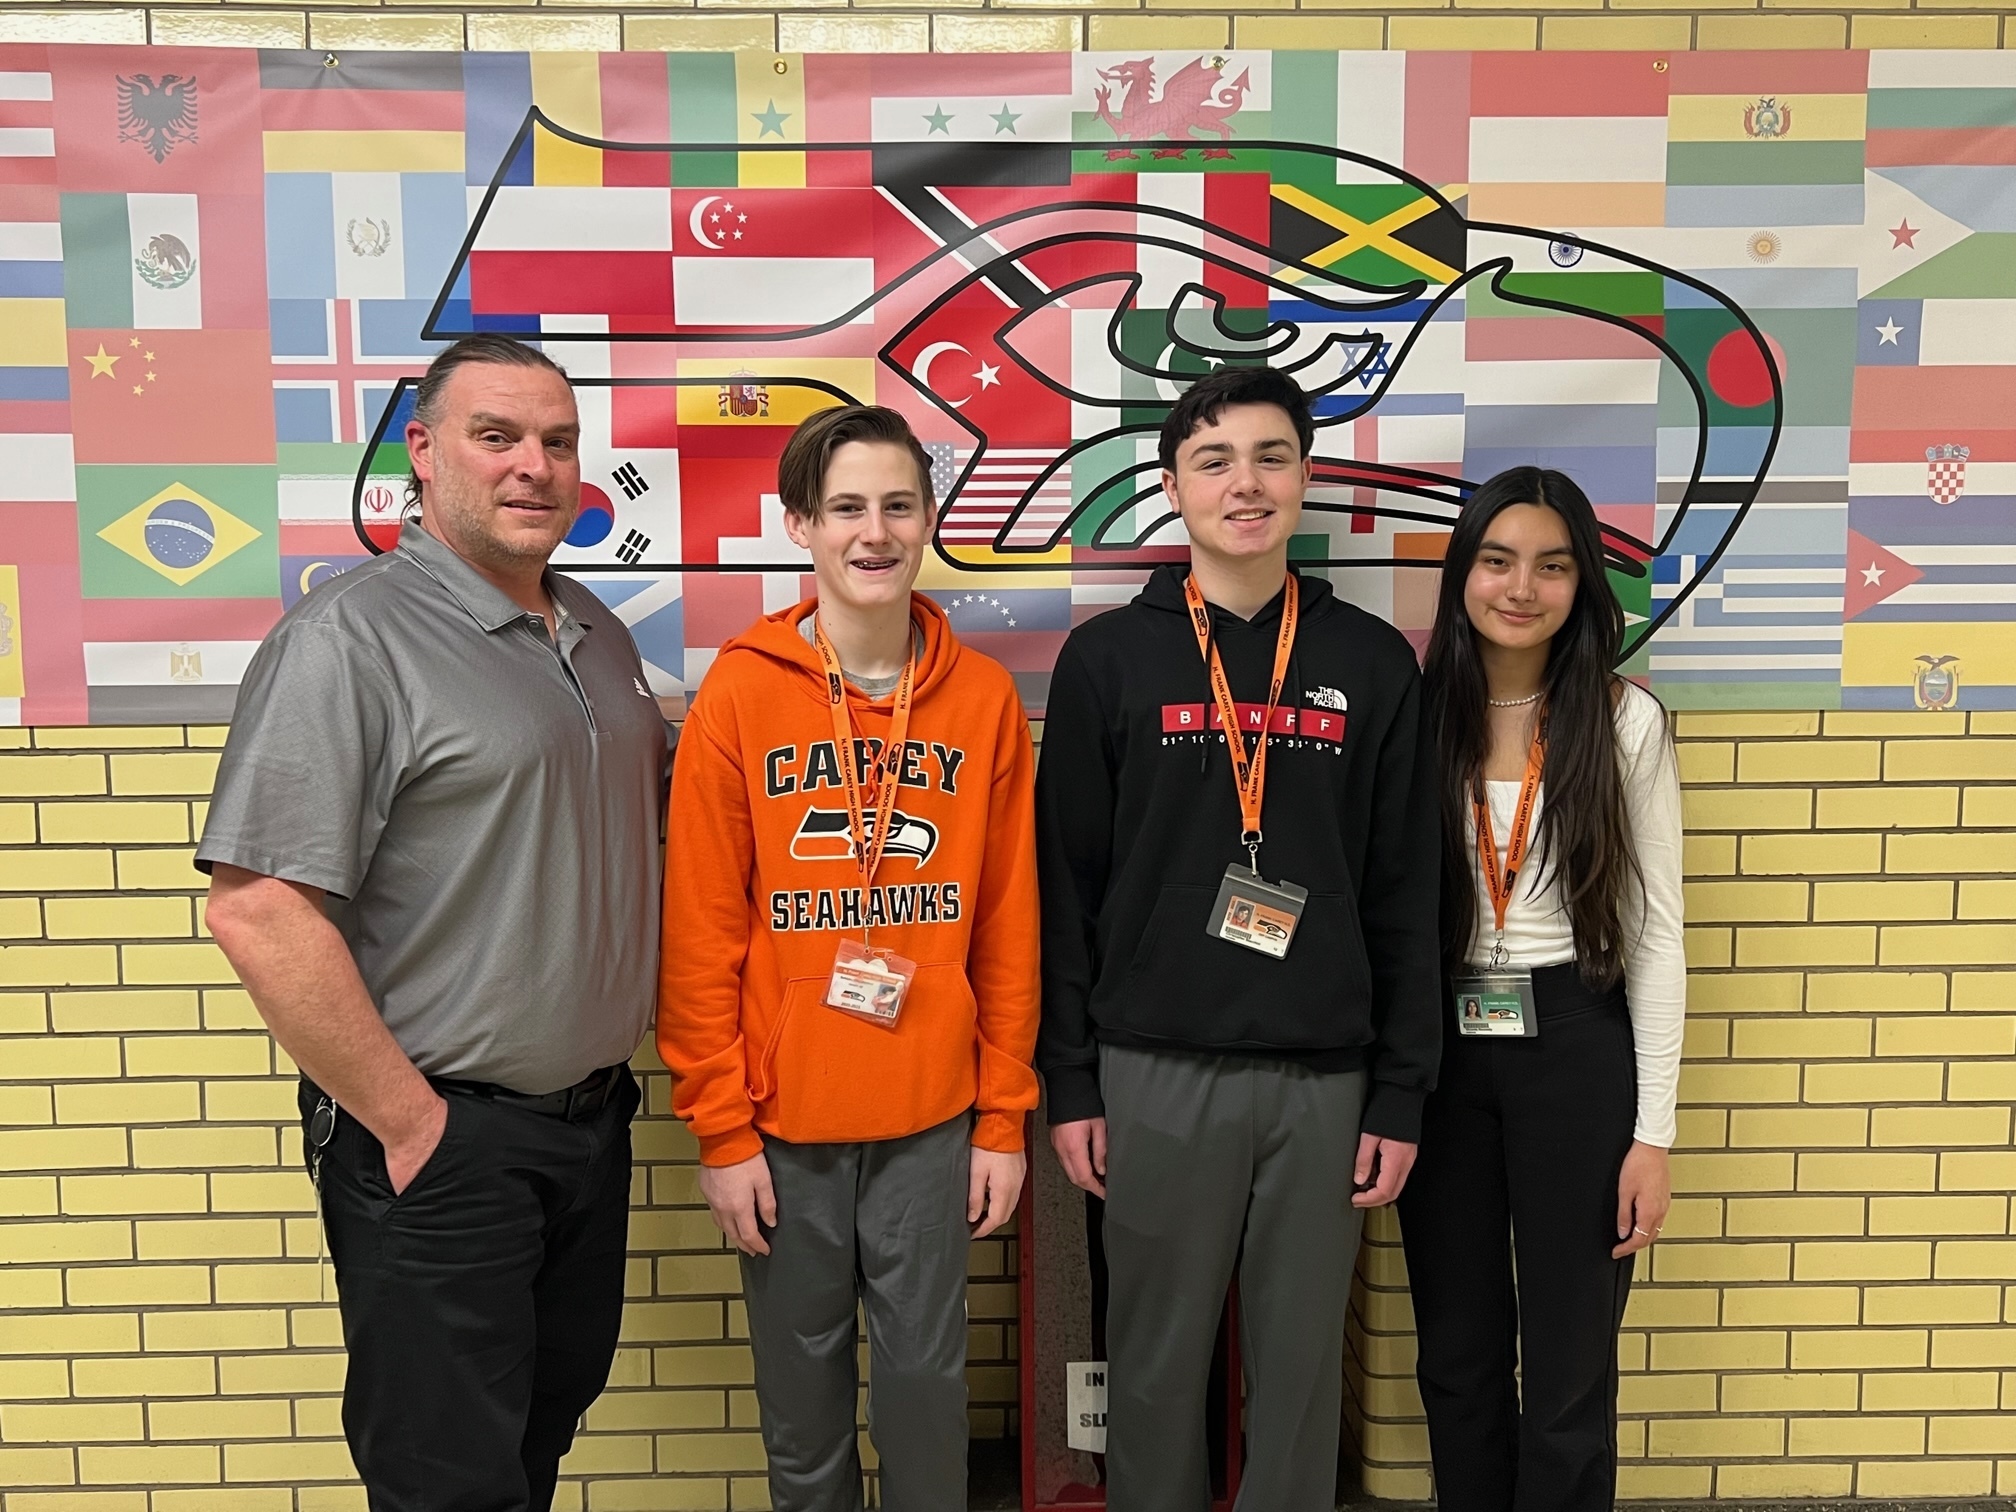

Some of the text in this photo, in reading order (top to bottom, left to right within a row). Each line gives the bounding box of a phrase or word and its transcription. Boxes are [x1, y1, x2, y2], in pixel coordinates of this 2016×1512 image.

[1283, 622, 1291, 641] FRANK
[821, 646, 832, 666] SCHOOL
[901, 682, 909, 702] FRANK
[1305, 690, 1334, 703] NORTH
[1318, 686, 1334, 695] THE
[1216, 674, 1225, 693] FRANK
[1221, 694, 1232, 713] CAREY
[1227, 714, 1235, 729] HIGH
[1231, 730, 1241, 754] SCHOOL
[1313, 699, 1334, 709] FACE
[1251, 736, 1281, 746] 15°
[1334, 746, 1343, 756] W
[765, 737, 965, 799] CAREY
[843, 747, 851, 769] FRANK
[846, 769, 854, 790] CAREY
[1251, 776, 1259, 797] FRANK
[883, 783, 893, 808] SCHOOL
[1525, 782, 1534, 803] FRANK
[851, 807, 860, 834] SCHOOL
[880, 809, 888, 826] HIGH
[1519, 803, 1529, 822] CAREY
[875, 826, 884, 846] CAREY
[1516, 822, 1525, 839] HIGH
[1483, 838, 1491, 854] HIGH
[1511, 839, 1521, 862] SCHOOL
[1486, 854, 1495, 874] CAREY
[1490, 873, 1499, 894] FRANK
[770, 882, 962, 932] SEAHAWKS
[1085, 1372, 1105, 1387] IN
